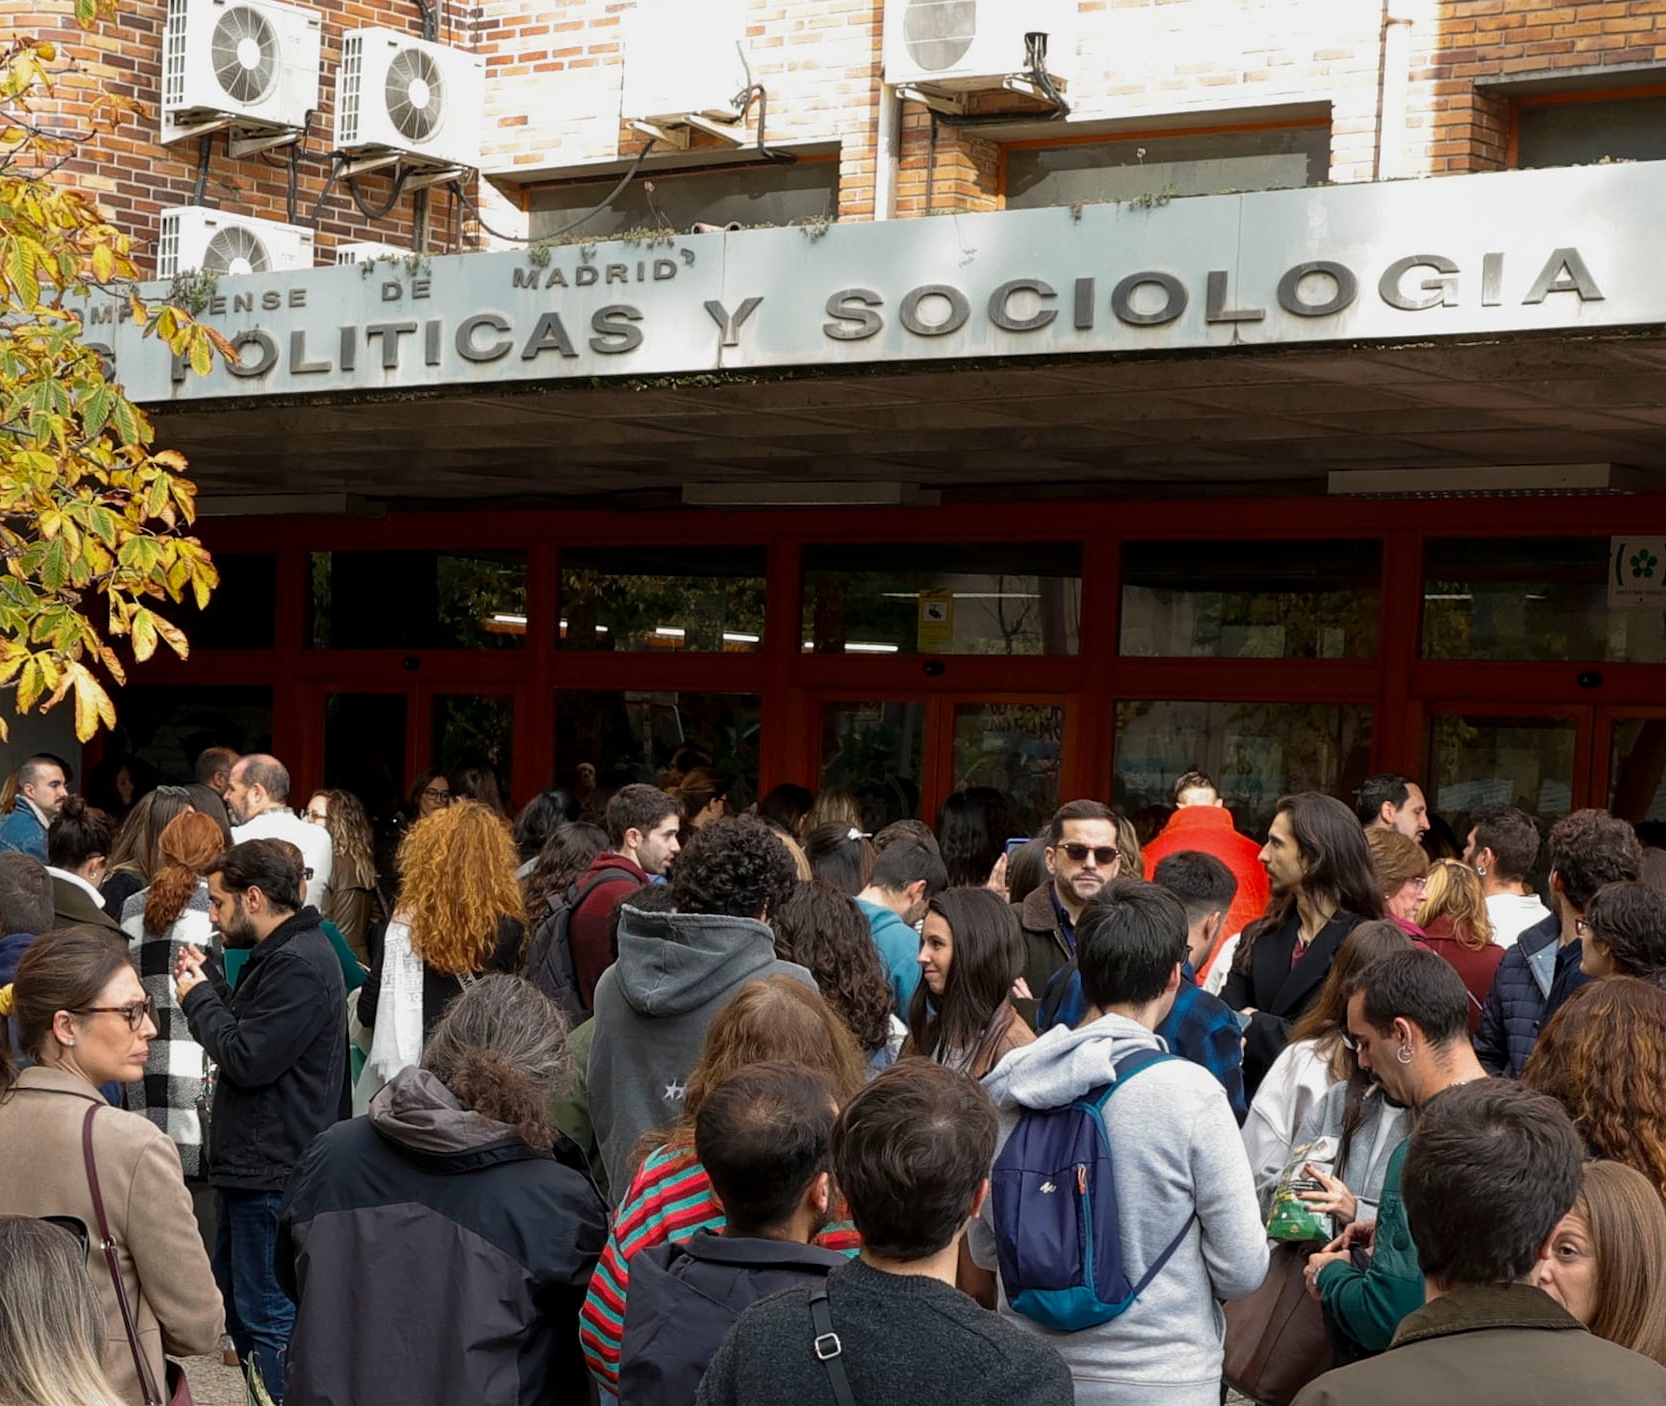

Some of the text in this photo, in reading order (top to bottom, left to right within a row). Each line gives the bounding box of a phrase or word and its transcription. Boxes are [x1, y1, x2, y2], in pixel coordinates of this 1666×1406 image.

[381, 279, 432, 301] DE
[512, 257, 679, 289] MADRID
[703, 296, 765, 347] Y
[822, 246, 1606, 342] SOCIOLOGIA
